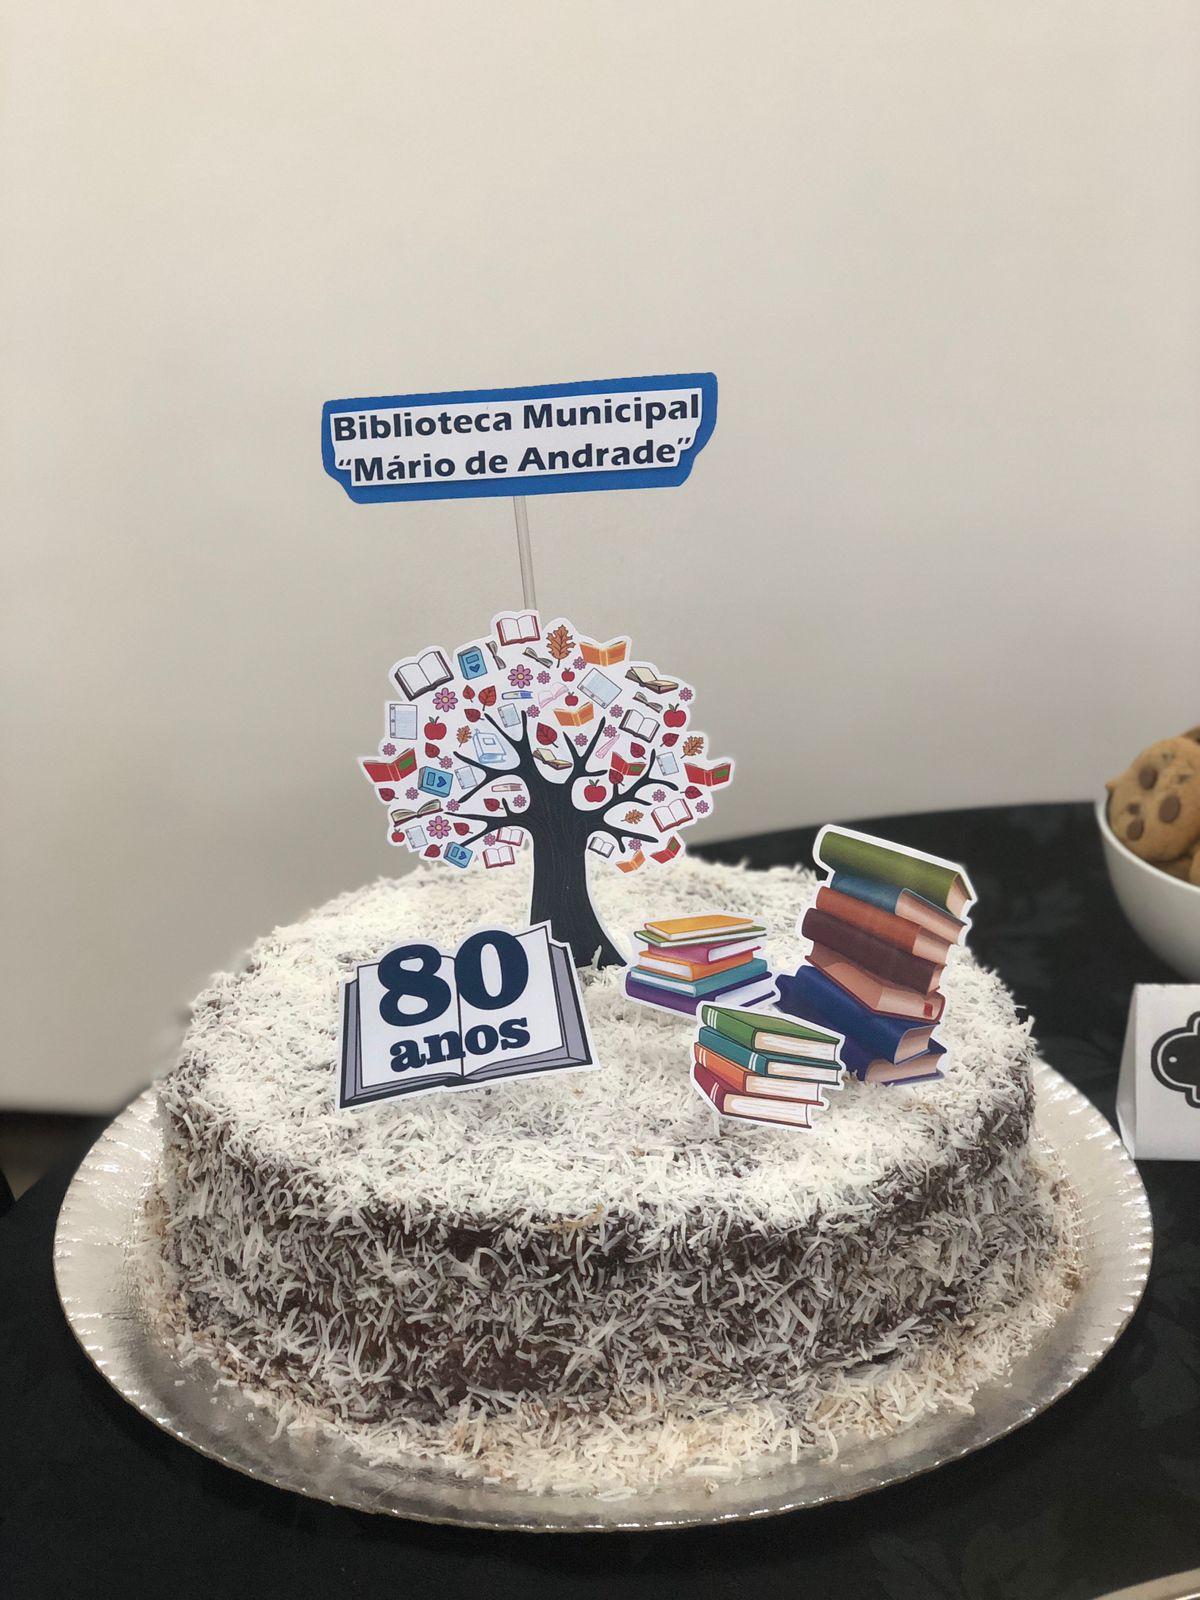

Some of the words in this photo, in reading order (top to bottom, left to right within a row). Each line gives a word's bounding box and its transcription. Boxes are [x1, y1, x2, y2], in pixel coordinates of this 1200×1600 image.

[333, 408, 512, 442] Biblioteca
[523, 393, 700, 429] Municipal
[465, 450, 508, 475] de
[377, 929, 529, 1027] 80
[389, 1017, 531, 1073] anos
